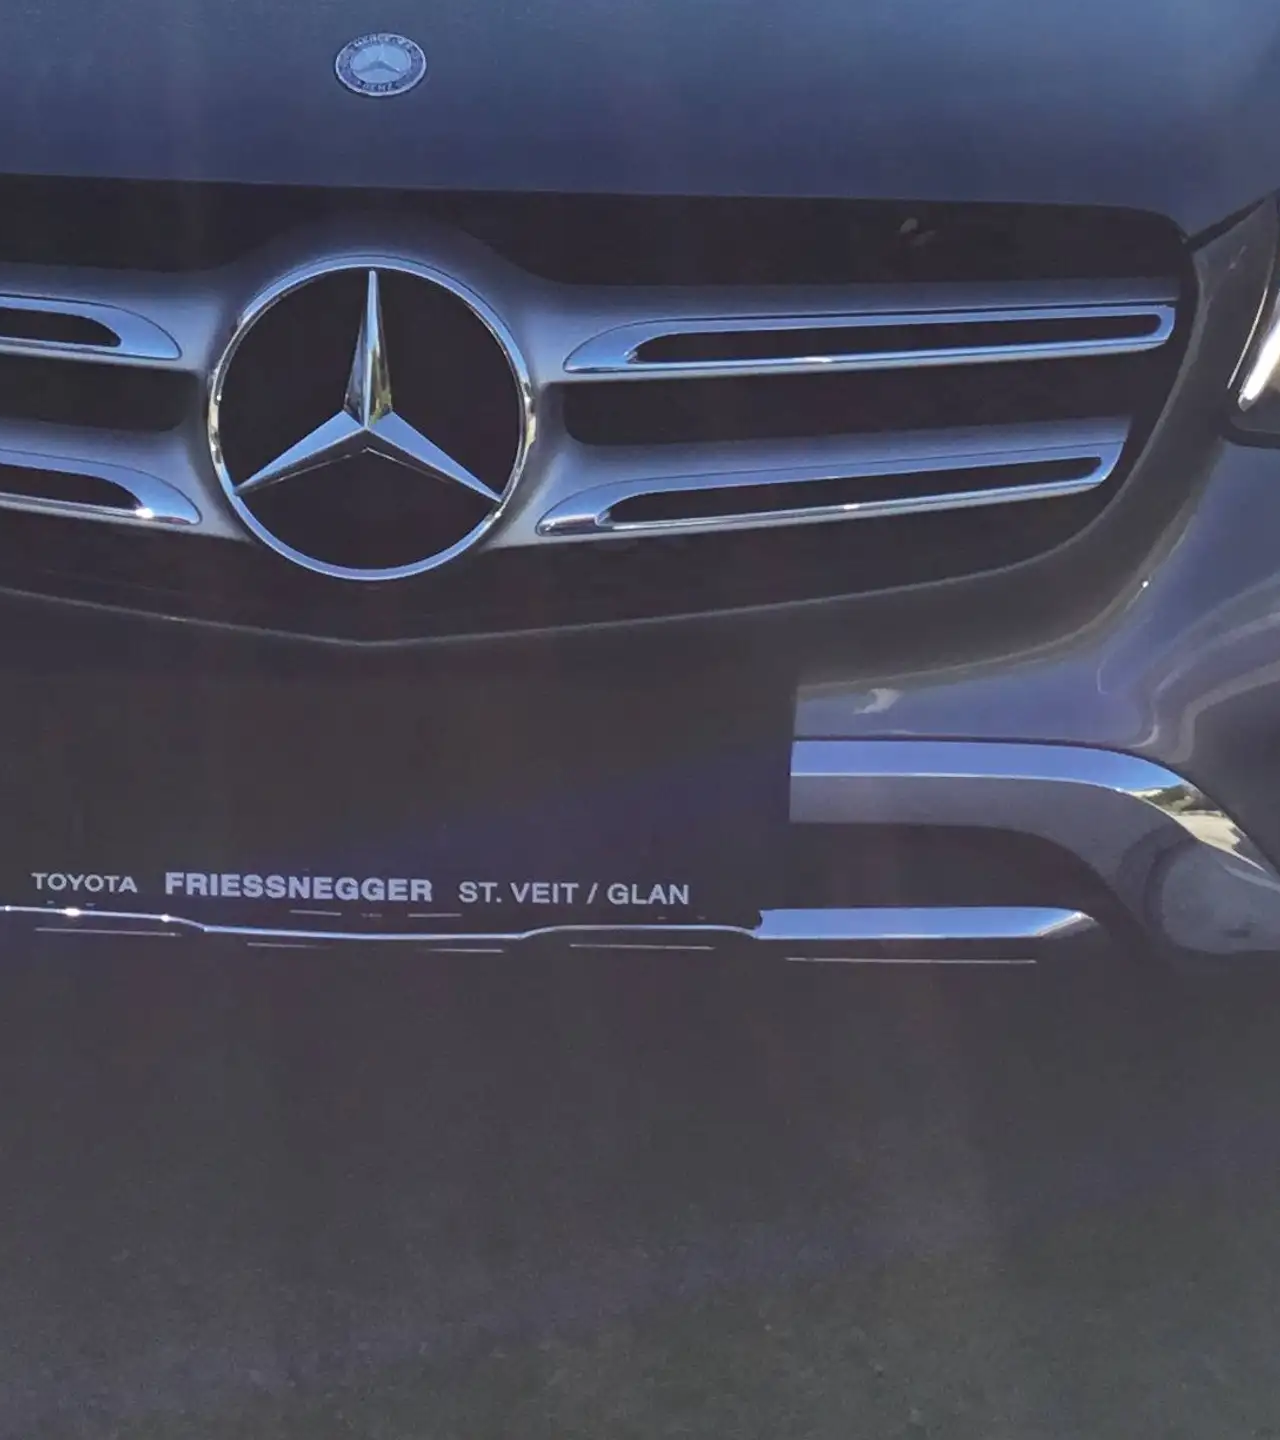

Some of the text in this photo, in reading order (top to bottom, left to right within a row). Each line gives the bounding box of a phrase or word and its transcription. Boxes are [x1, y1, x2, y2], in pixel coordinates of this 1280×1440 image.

[31, 872, 690, 905] TOYOTA FRIESSNEGGER ST. VEIT / GLAN
